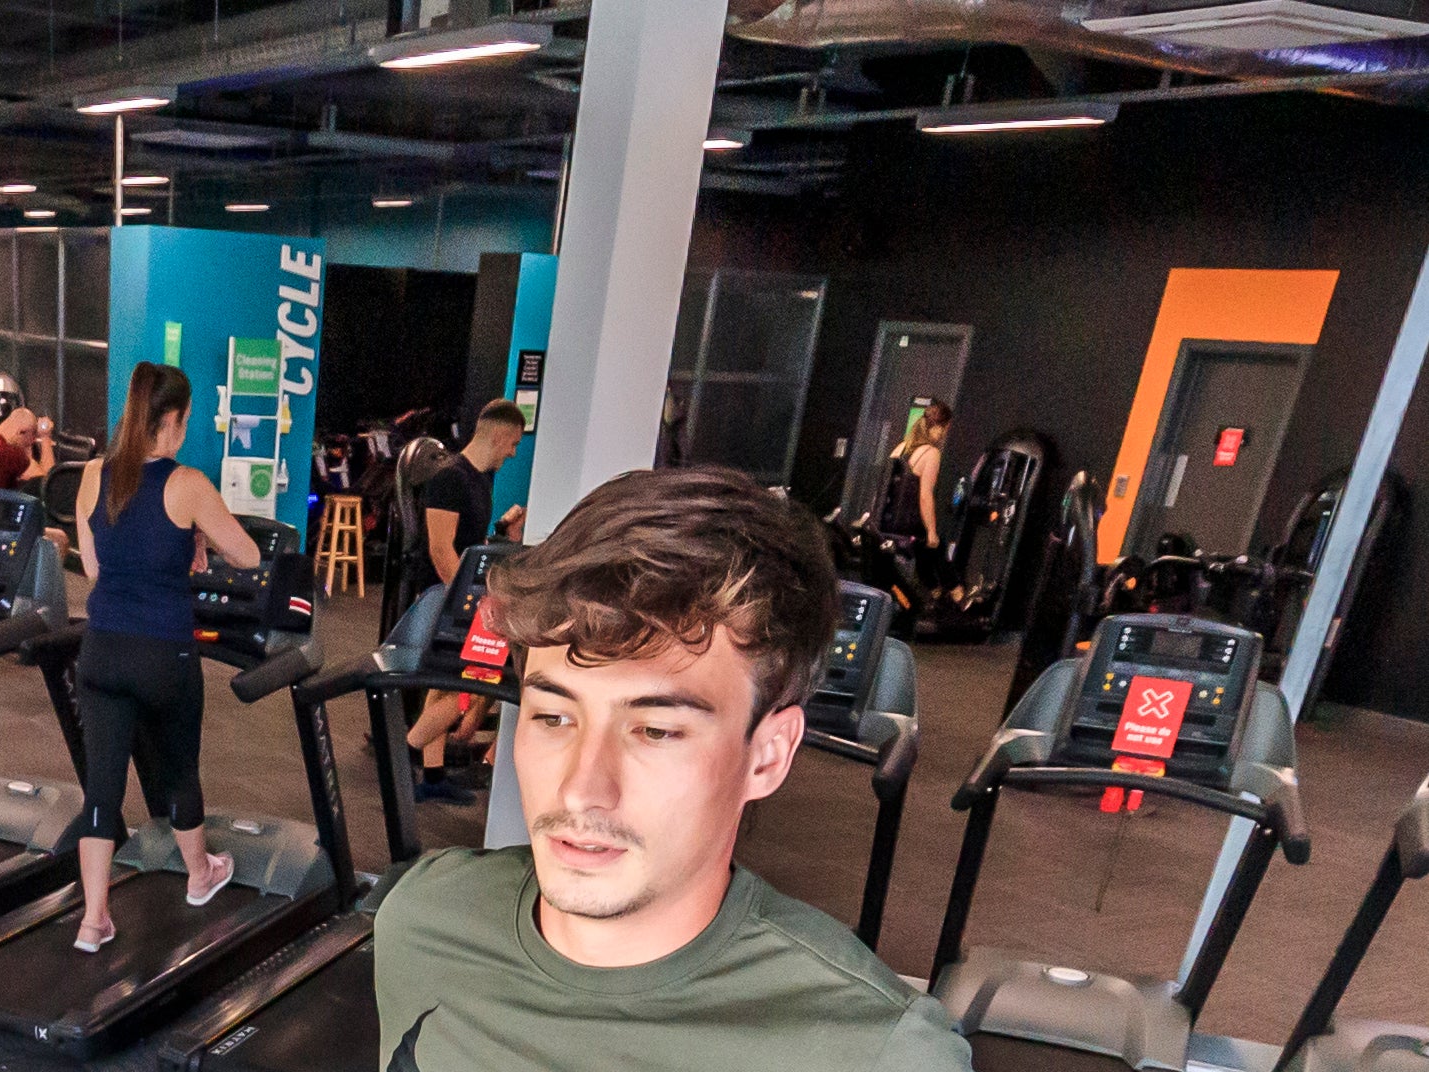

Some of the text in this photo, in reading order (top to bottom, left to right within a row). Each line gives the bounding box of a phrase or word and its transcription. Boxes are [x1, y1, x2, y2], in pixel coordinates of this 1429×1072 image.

[277, 244, 321, 397] CYCLE
[236, 353, 278, 369] Cleaning
[238, 367, 274, 380] Station
[1124, 721, 1172, 738] Please do
[1126, 733, 1164, 746] not use
